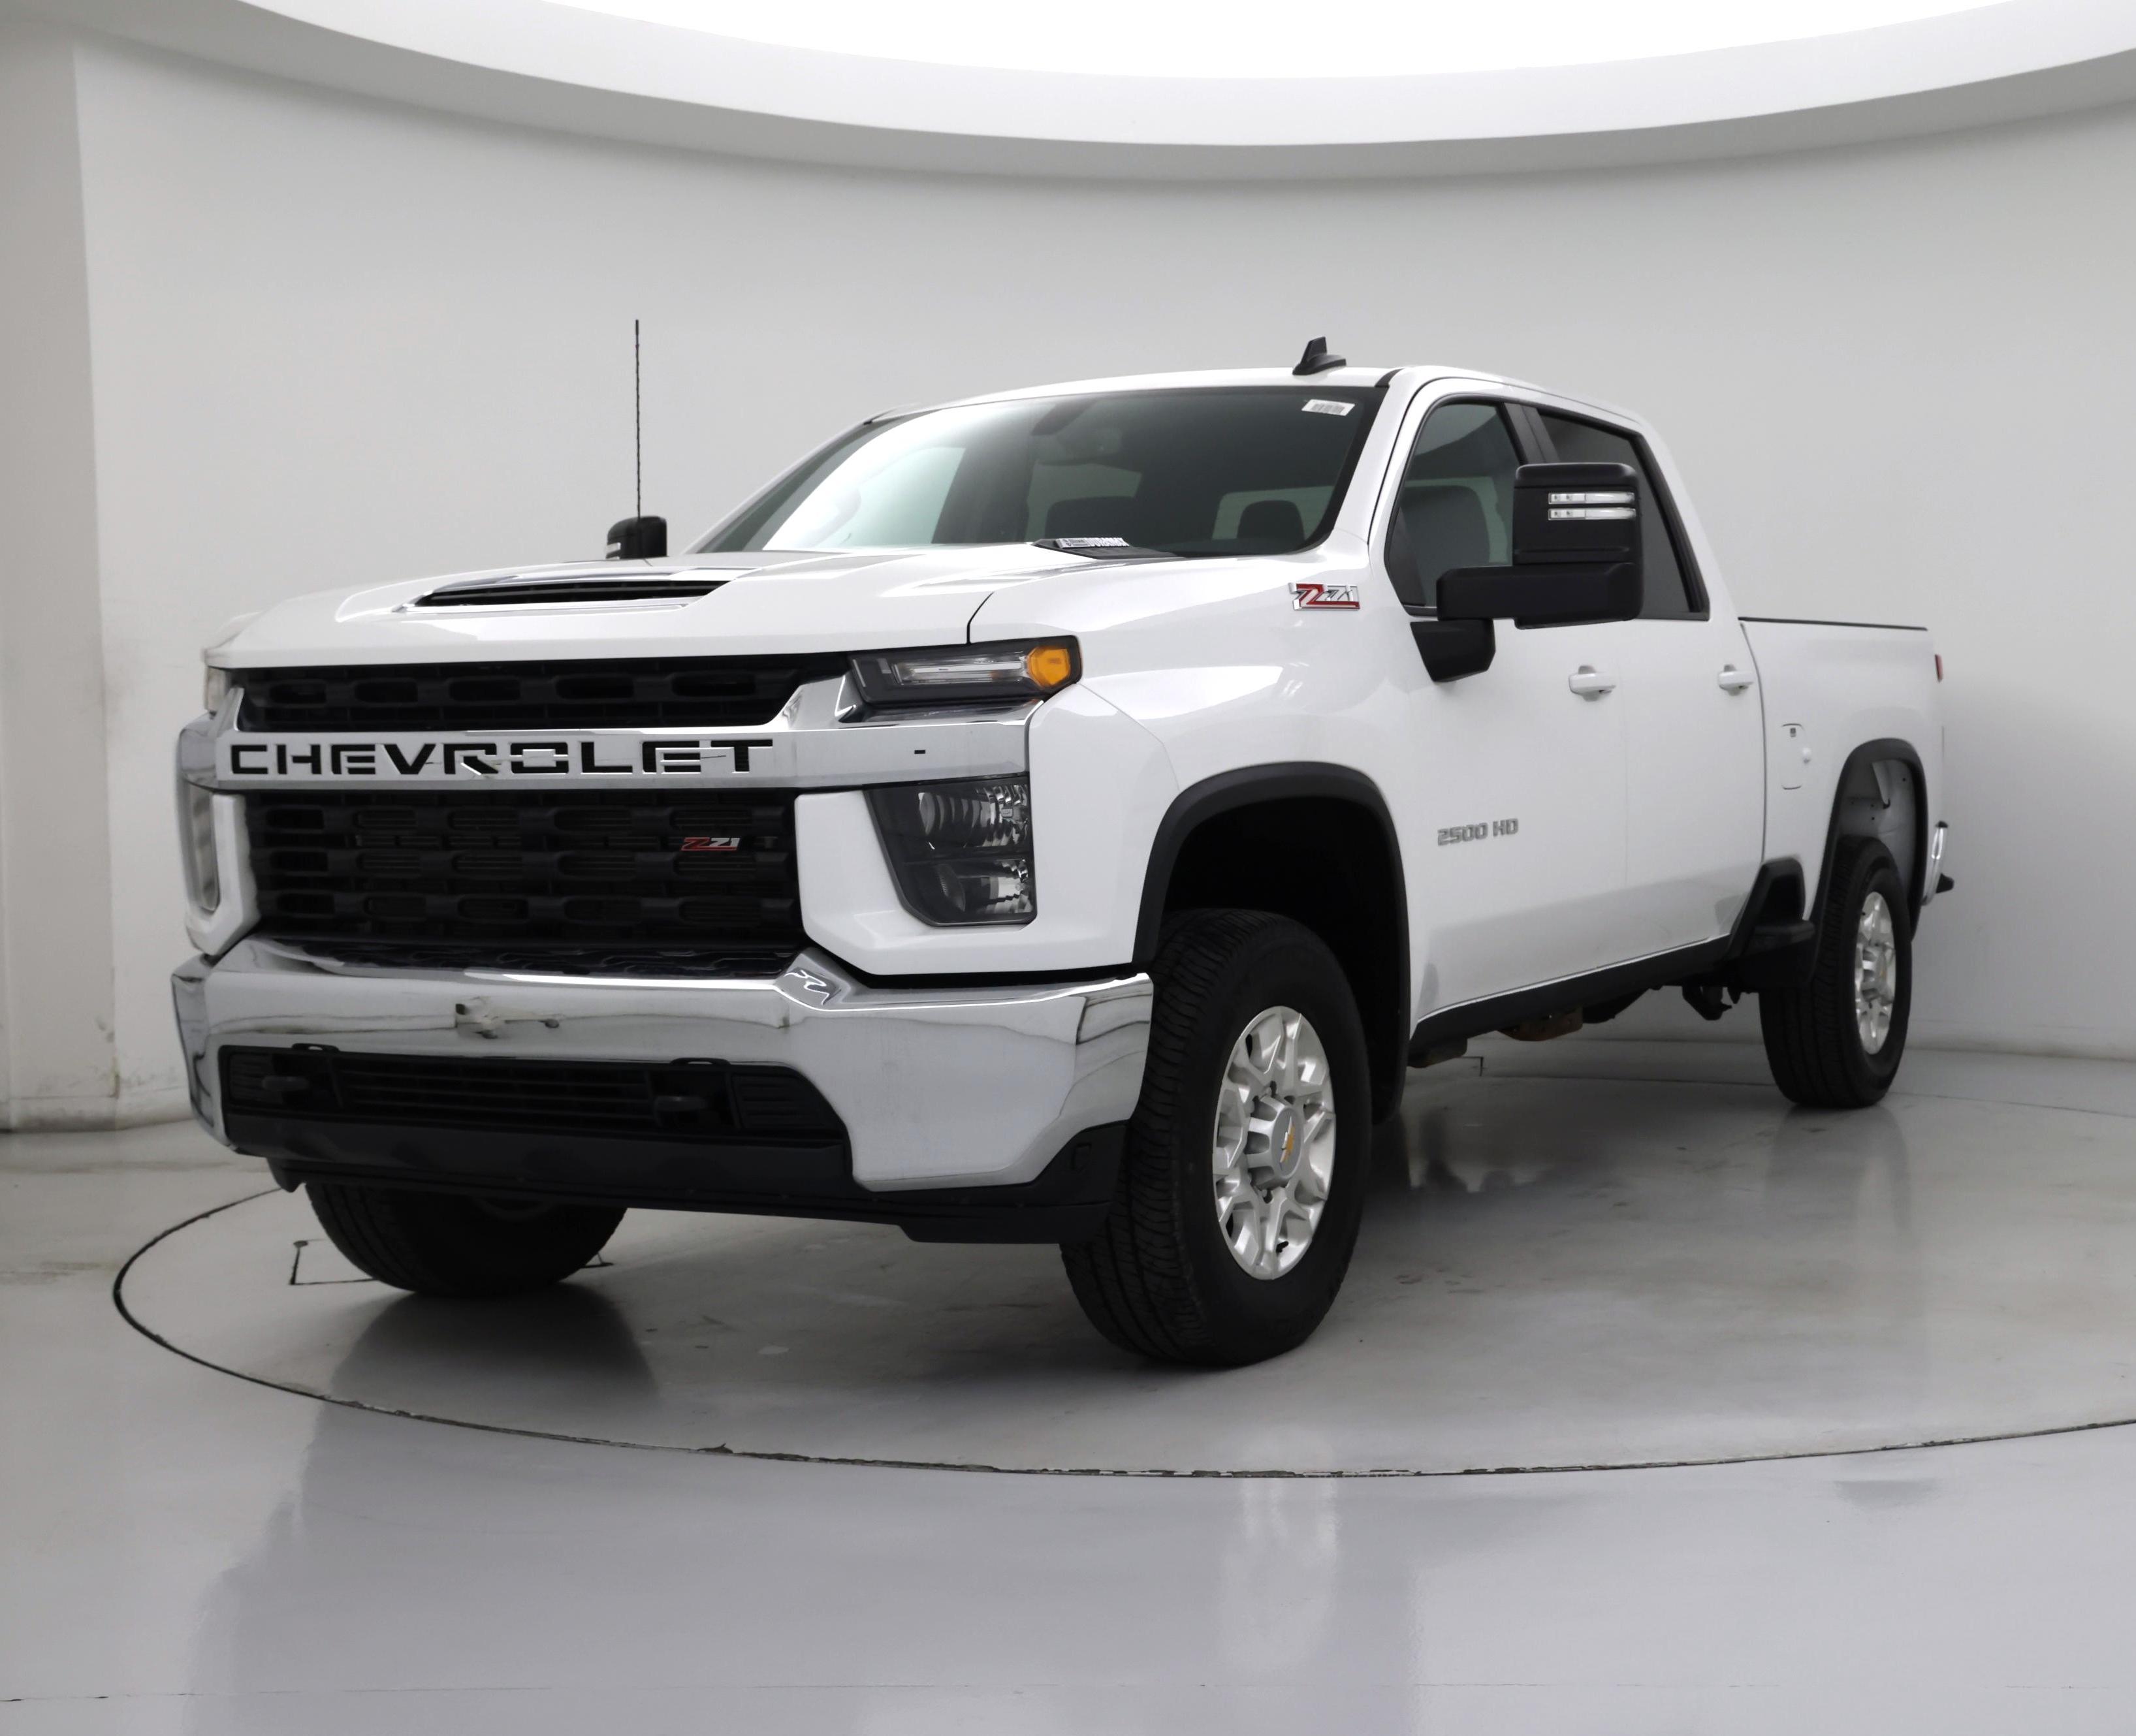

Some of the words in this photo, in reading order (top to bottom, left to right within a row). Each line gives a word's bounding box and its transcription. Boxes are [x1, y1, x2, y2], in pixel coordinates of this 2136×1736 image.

[1288, 582, 1360, 610] Z71
[231, 739, 773, 775] CHEVROLET
[681, 837, 740, 851] Z71
[1437, 822, 1488, 846] 2500
[1493, 818, 1519, 836] HD
